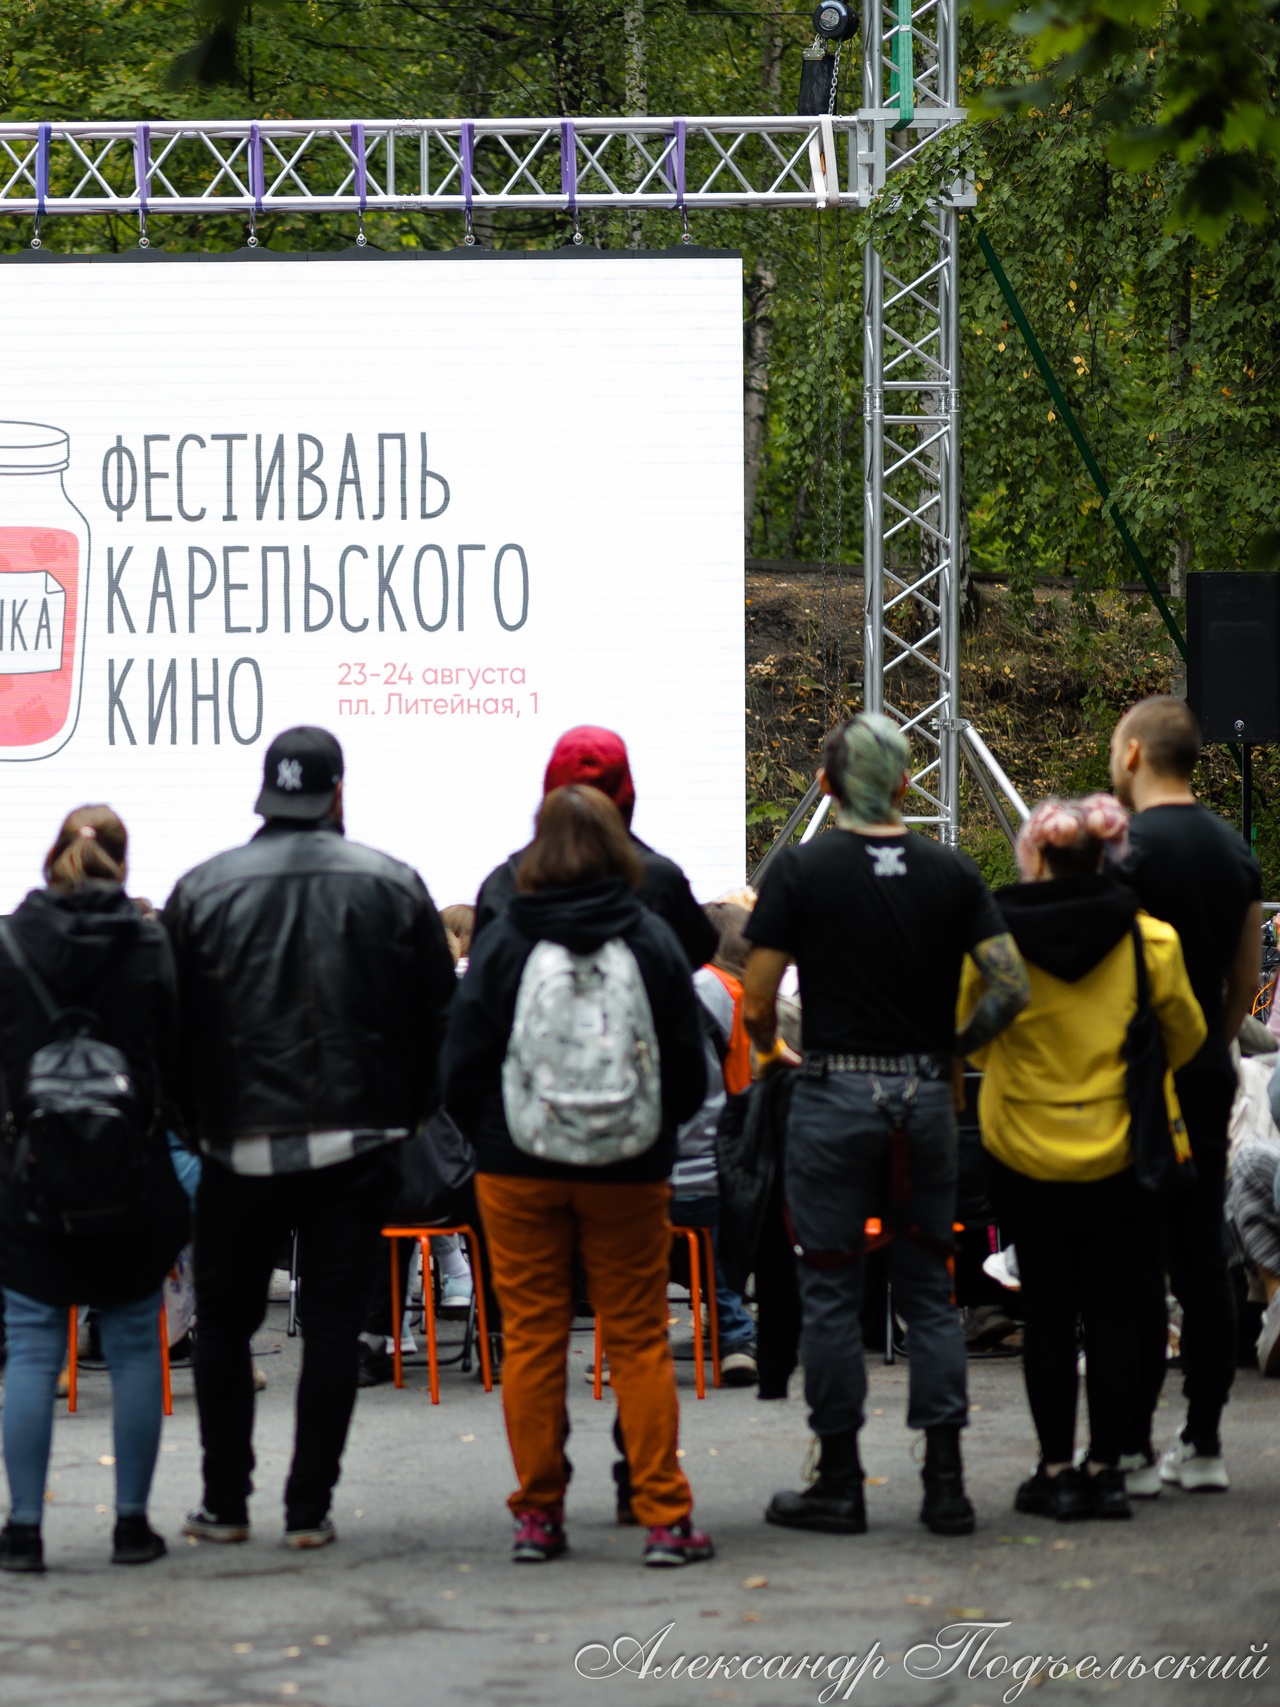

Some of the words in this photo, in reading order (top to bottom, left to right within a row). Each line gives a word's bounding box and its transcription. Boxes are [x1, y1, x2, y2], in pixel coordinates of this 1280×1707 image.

[101, 431, 451, 523] ФЕСТИВАЛЬ
[106, 543, 530, 634] КАРЕЛЬСКОГО
[107, 656, 264, 746] КИНО
[337, 662, 414, 686] 23-24
[422, 667, 526, 690] августа
[338, 699, 376, 715] пл.
[384, 692, 520, 718] Литейная,
[530, 692, 539, 714] 1
